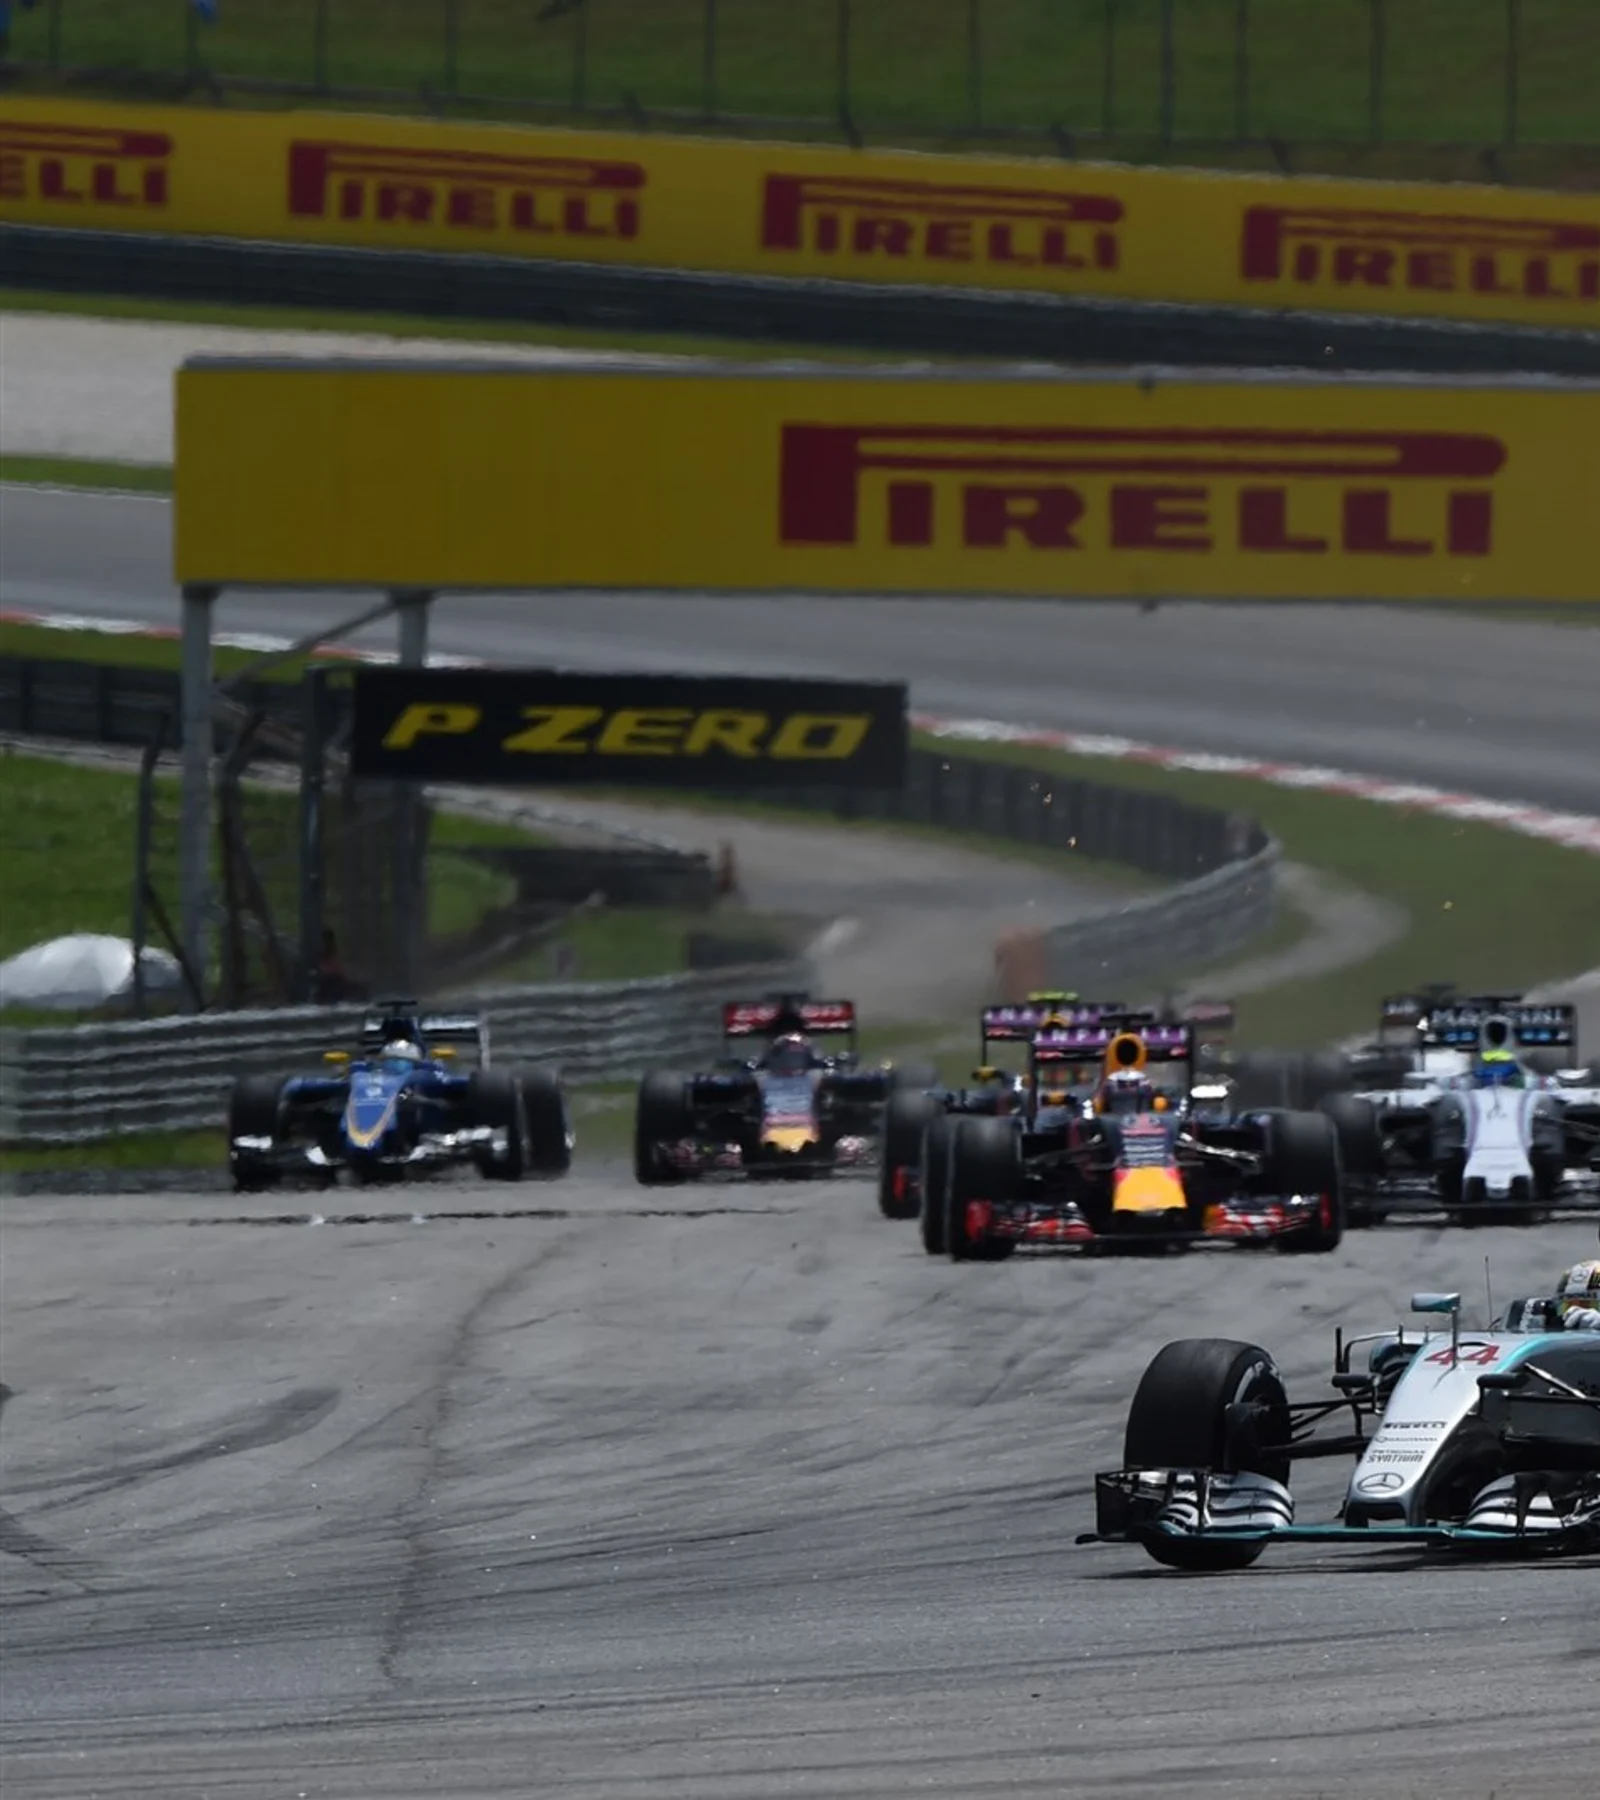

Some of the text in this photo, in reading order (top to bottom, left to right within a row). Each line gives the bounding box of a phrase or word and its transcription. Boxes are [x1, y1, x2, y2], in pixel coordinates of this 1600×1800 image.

[287, 140, 646, 239] PIRELLI
[761, 173, 1125, 269] PIRELLI
[778, 422, 1507, 556] PIRELLI
[382, 703, 870, 758] P ZERO
[1424, 1344, 1500, 1366] 44
